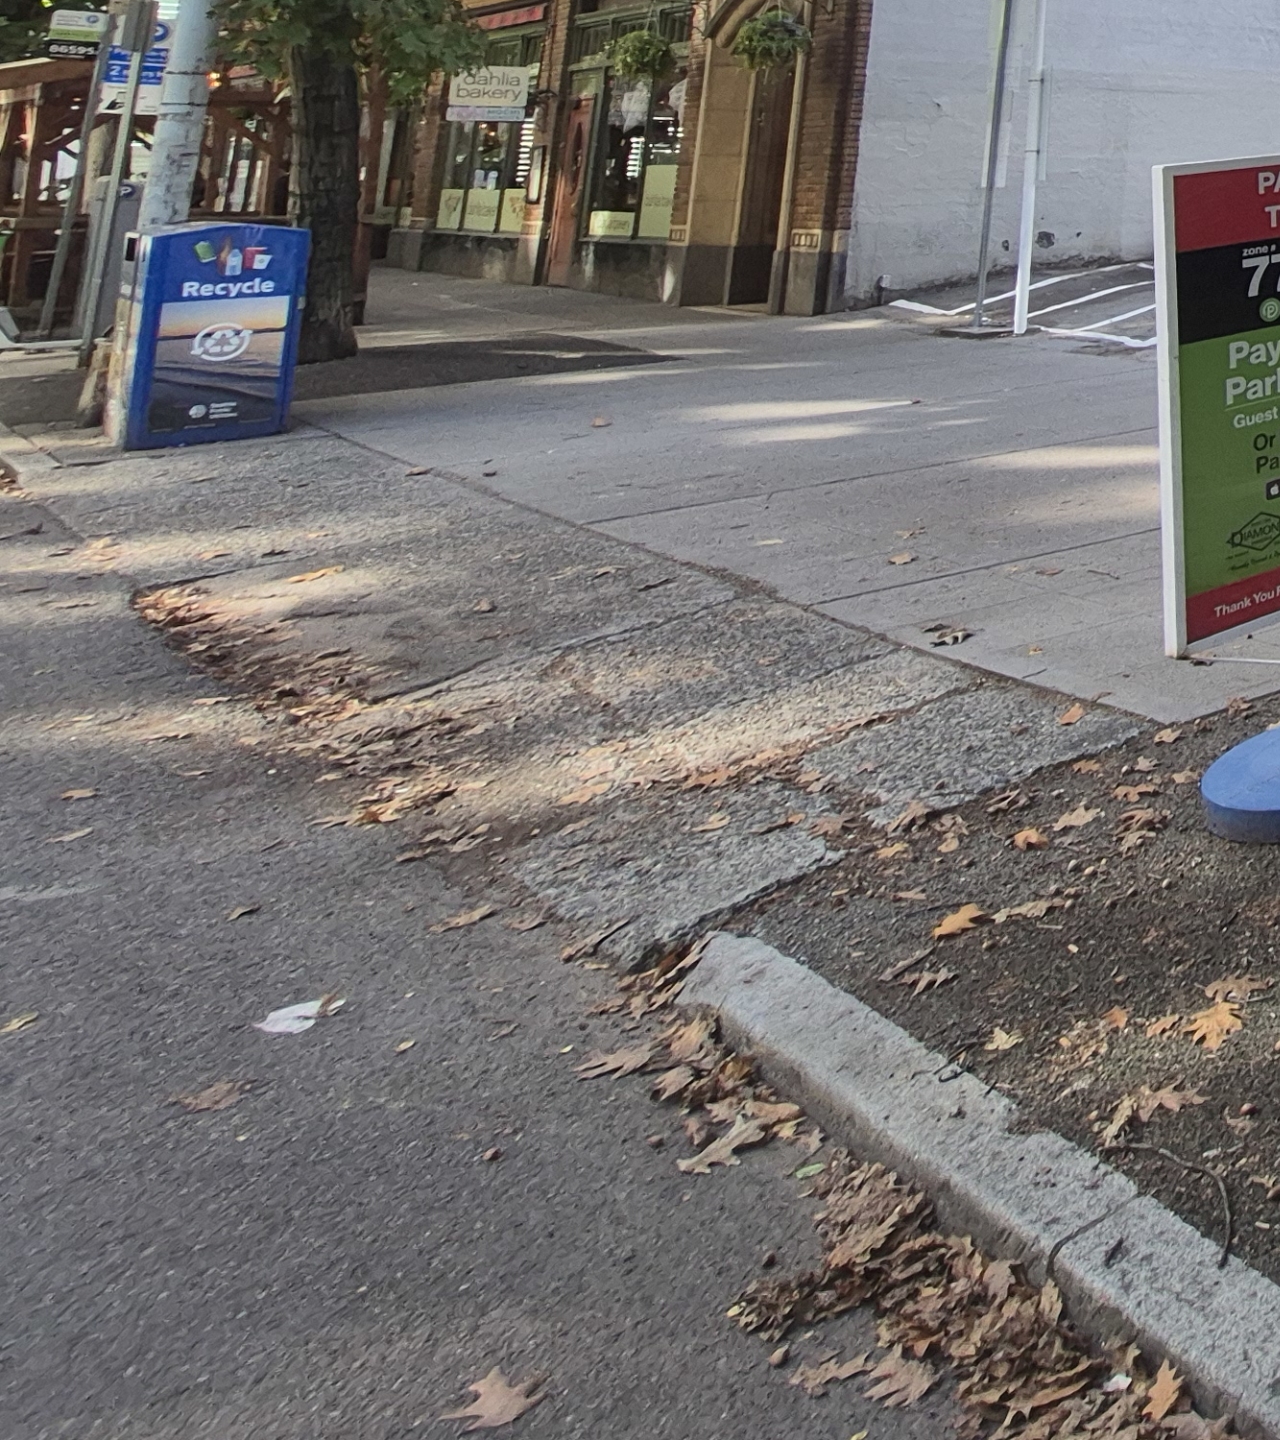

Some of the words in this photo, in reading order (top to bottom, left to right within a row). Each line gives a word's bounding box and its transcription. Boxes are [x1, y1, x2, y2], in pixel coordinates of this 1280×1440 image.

[464, 71, 520, 86] dahlia
[456, 84, 522, 102] bakery
[1242, 244, 1269, 257] zone
[181, 277, 276, 298] Recycle
[1233, 408, 1279, 429] Guest
[1253, 432, 1276, 452] Or
[1214, 596, 1252, 618] Thank
[1252, 589, 1275, 607] You
